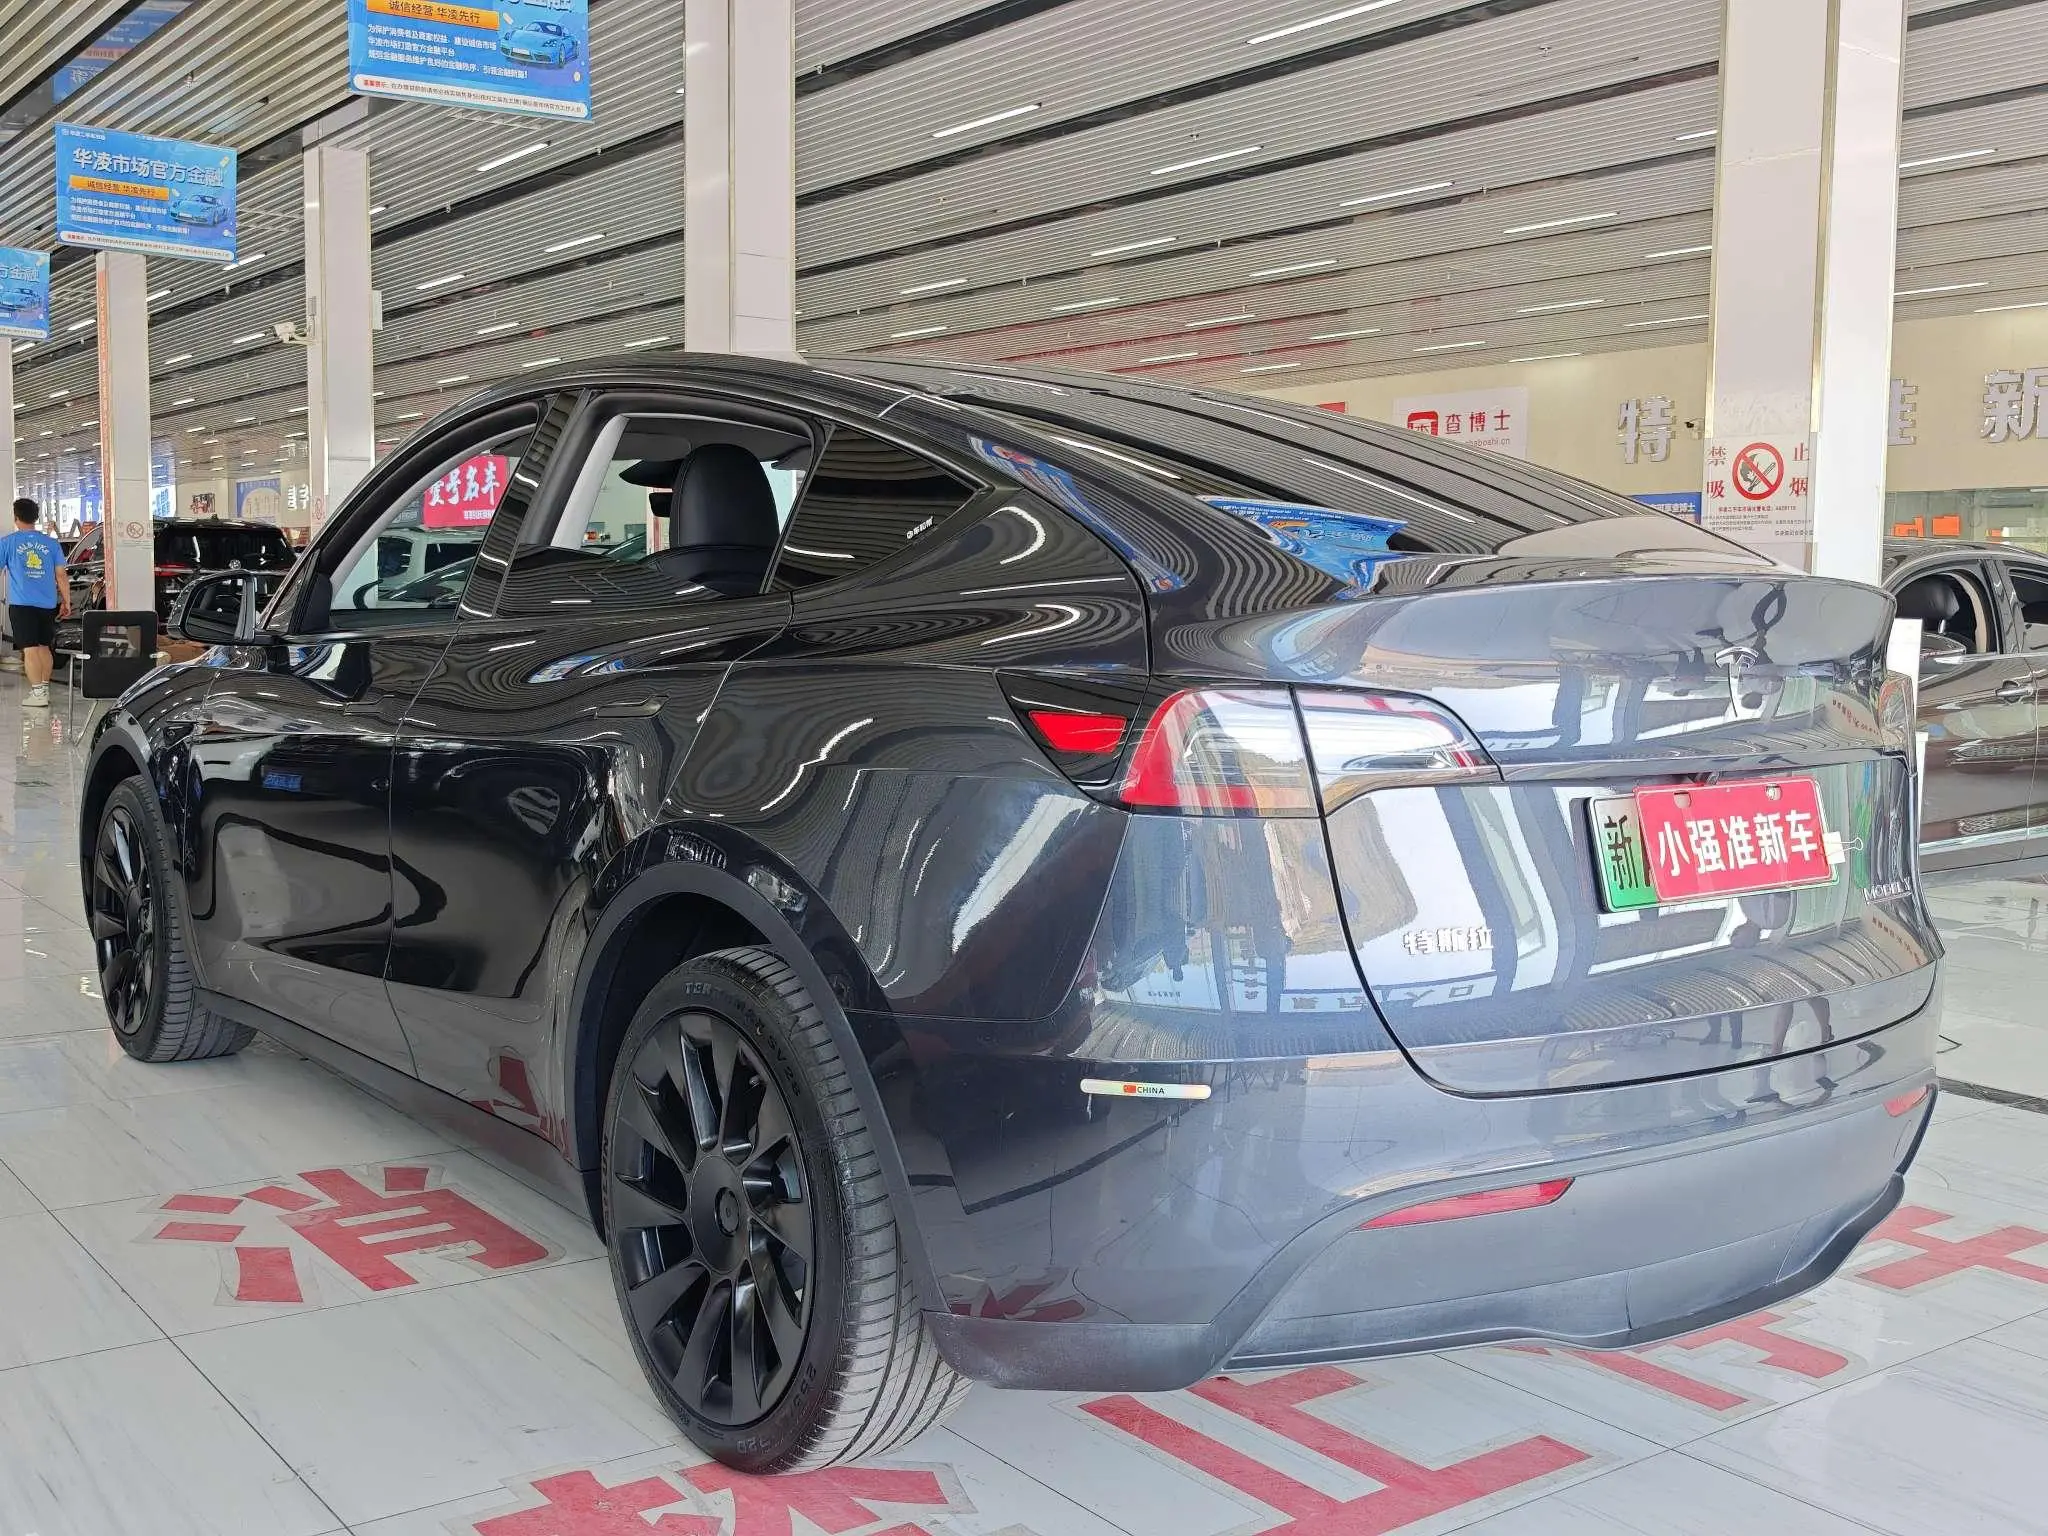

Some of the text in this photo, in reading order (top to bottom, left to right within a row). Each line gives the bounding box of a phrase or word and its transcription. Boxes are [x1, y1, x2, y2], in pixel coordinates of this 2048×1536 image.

[388, 0, 481, 24] 诚信经营 华凌先行
[72, 147, 225, 189] 华凌市场官方金融
[1445, 409, 1511, 435] 查博士
[1656, 810, 1820, 877] 小强准新车
[1863, 881, 1903, 902] MODEL
[1403, 926, 1495, 955] 特斯拉
[1136, 1085, 1165, 1095] CHINA
